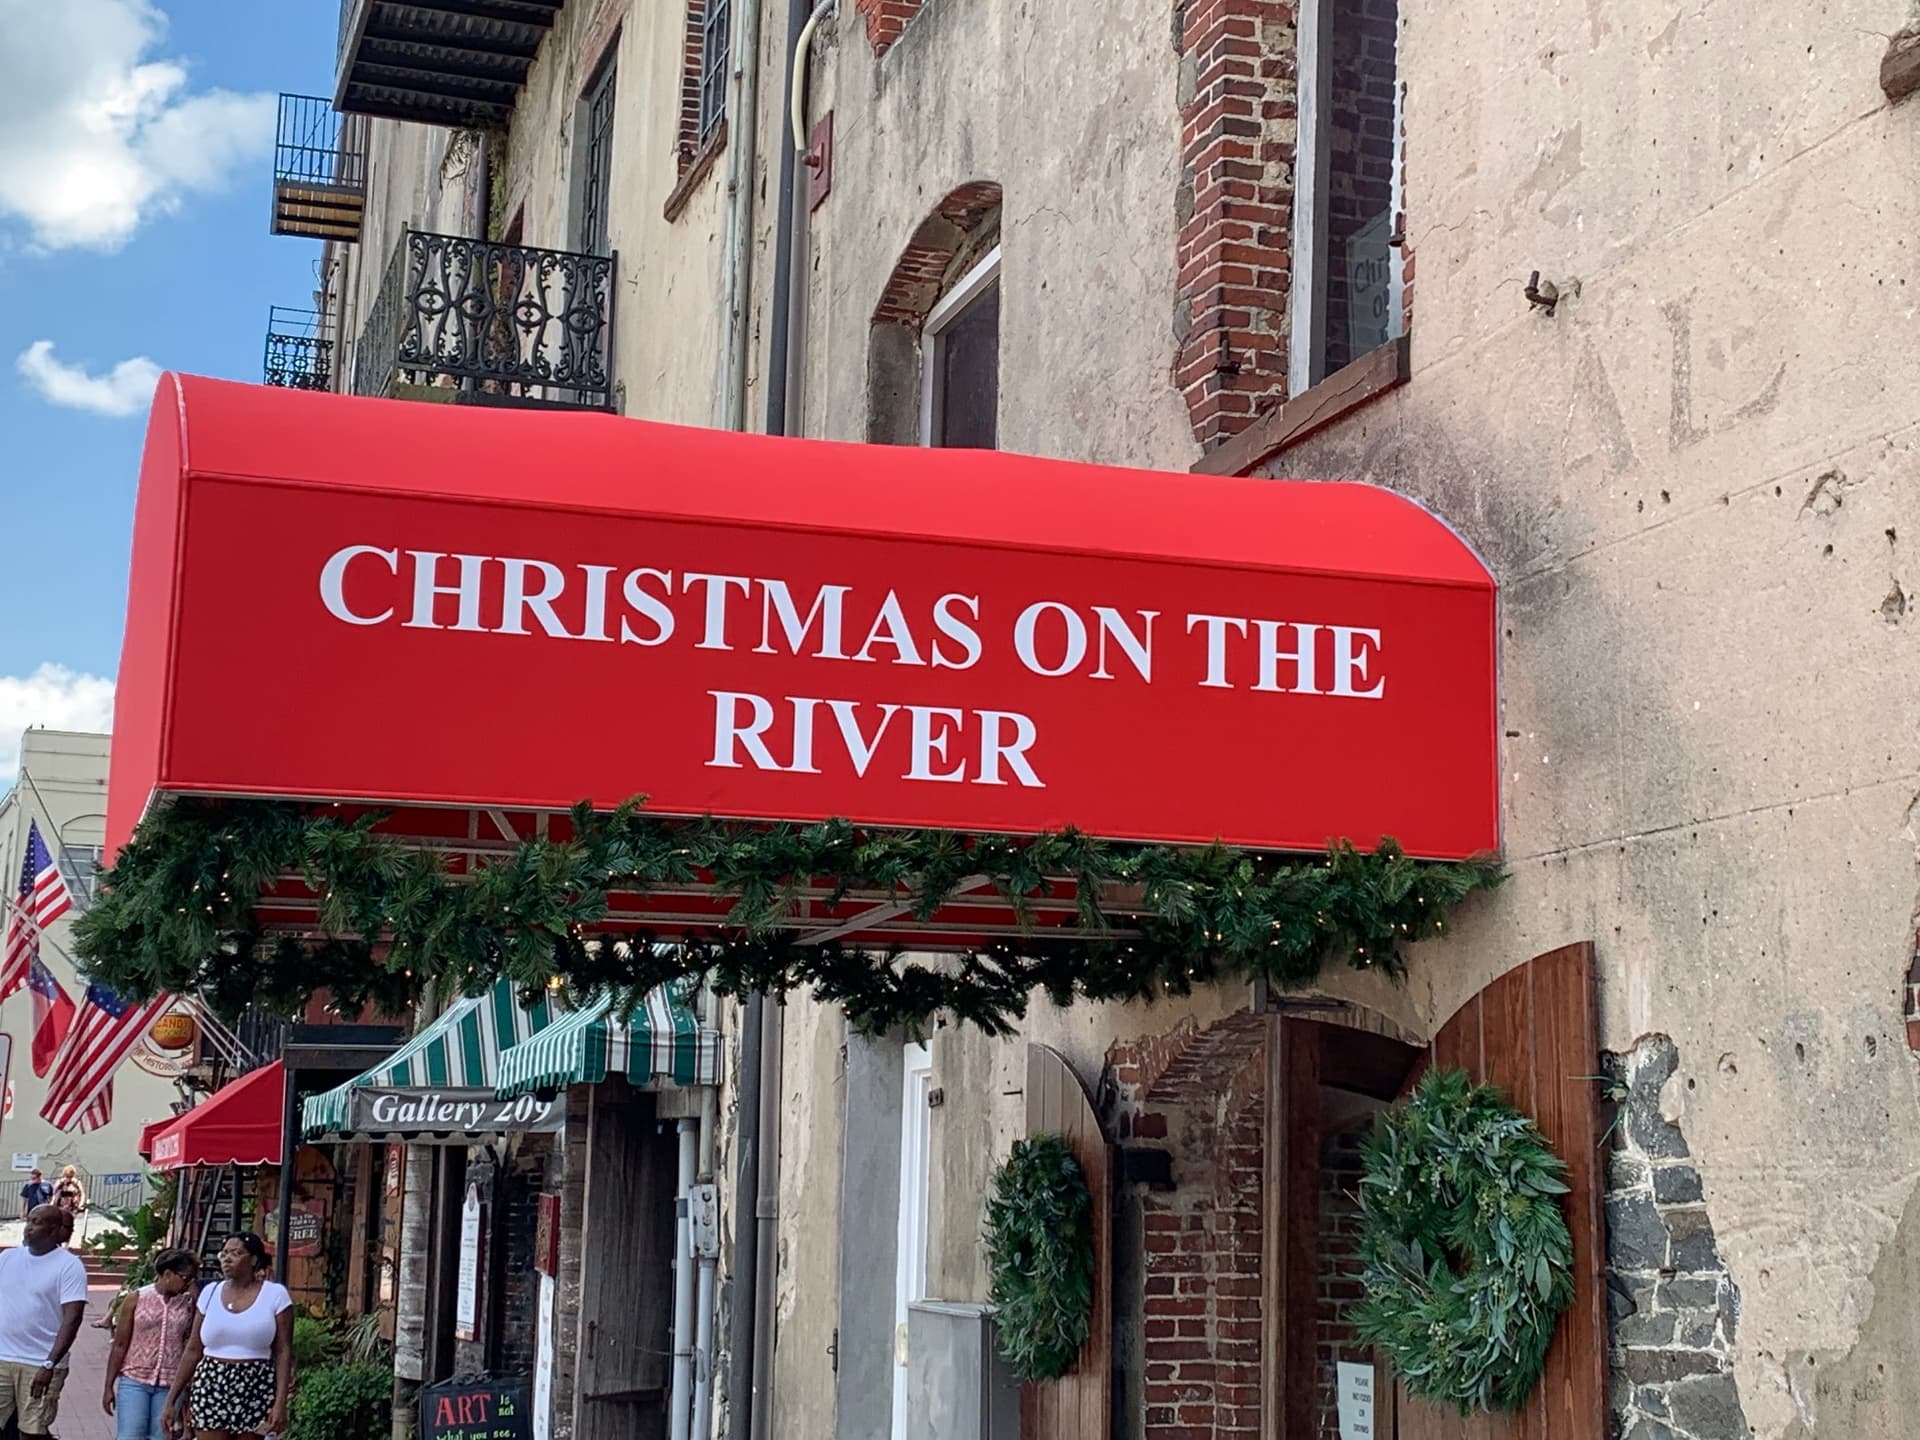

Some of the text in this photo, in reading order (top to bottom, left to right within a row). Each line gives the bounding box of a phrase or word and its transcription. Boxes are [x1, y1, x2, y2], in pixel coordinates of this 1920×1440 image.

[319, 544, 1386, 700] CHRISTMAS ON THE
[703, 689, 1046, 788] RIVER
[371, 1094, 552, 1129] Gallery 209
[434, 1393, 492, 1427] ART
